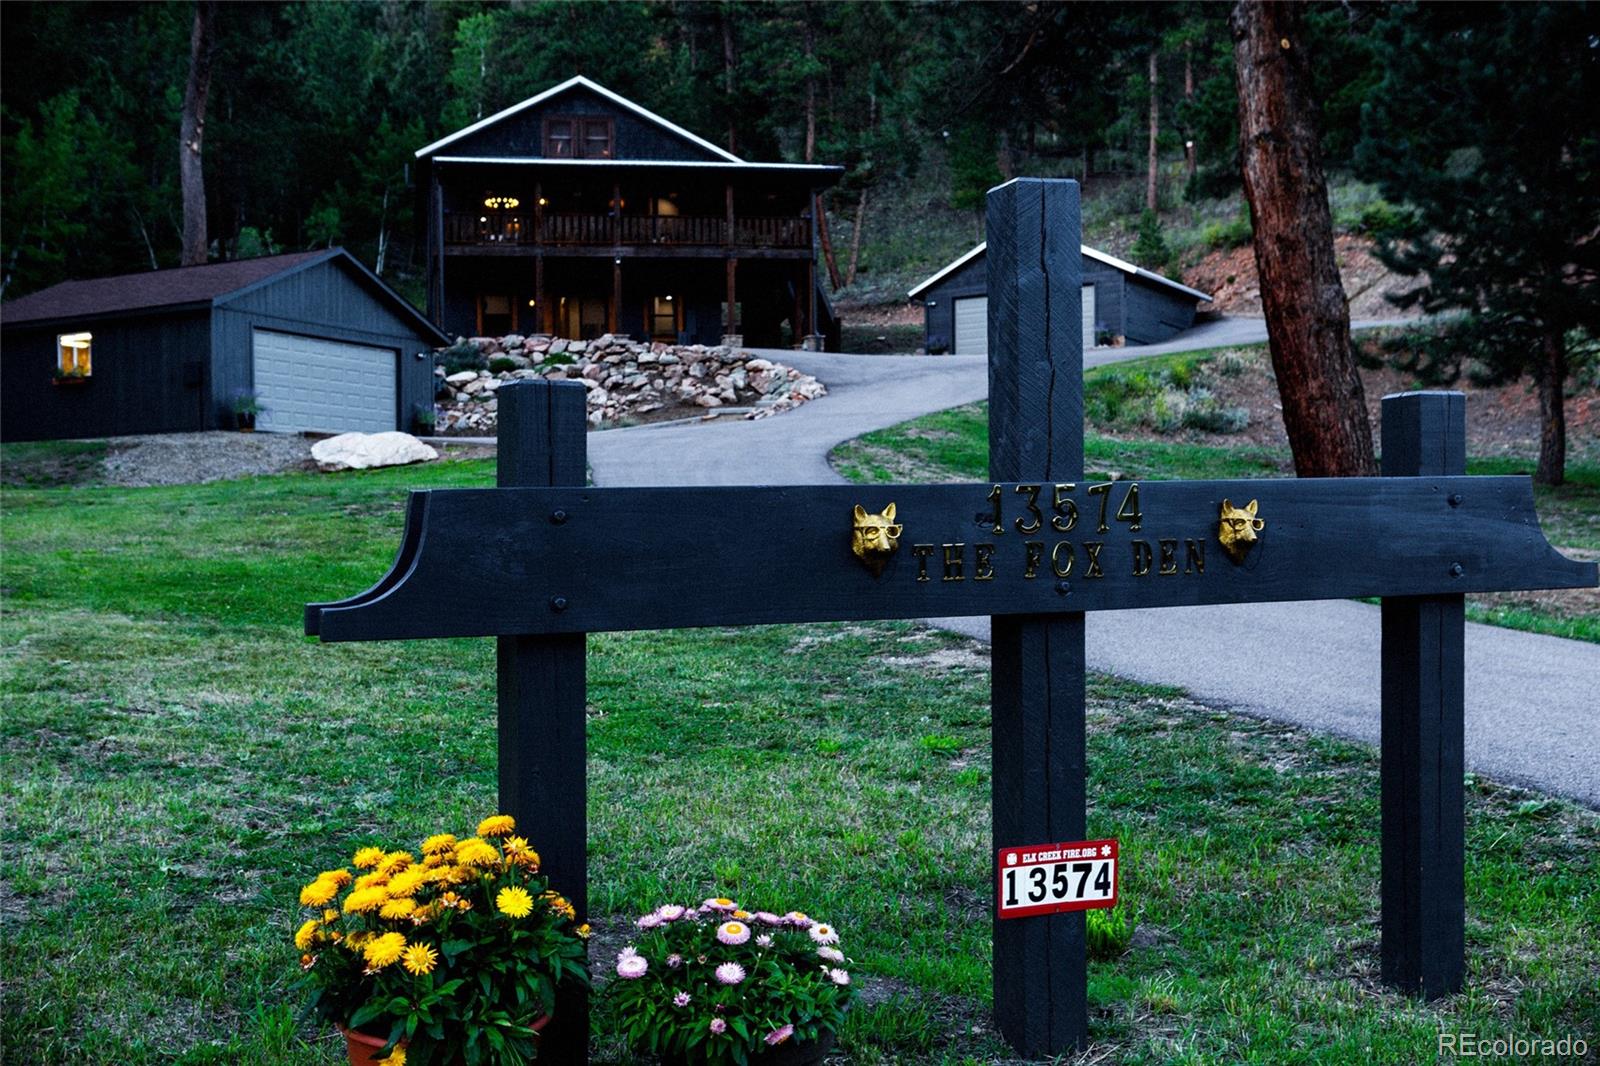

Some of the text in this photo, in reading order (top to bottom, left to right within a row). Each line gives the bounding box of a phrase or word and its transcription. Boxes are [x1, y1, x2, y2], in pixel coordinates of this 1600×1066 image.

[988, 483, 1143, 535] 13574
[911, 538, 1206, 582] THE FOX DEN
[1022, 848, 1097, 864] ELK CREEK FIRE.ORG
[1006, 862, 1111, 906] 13574
